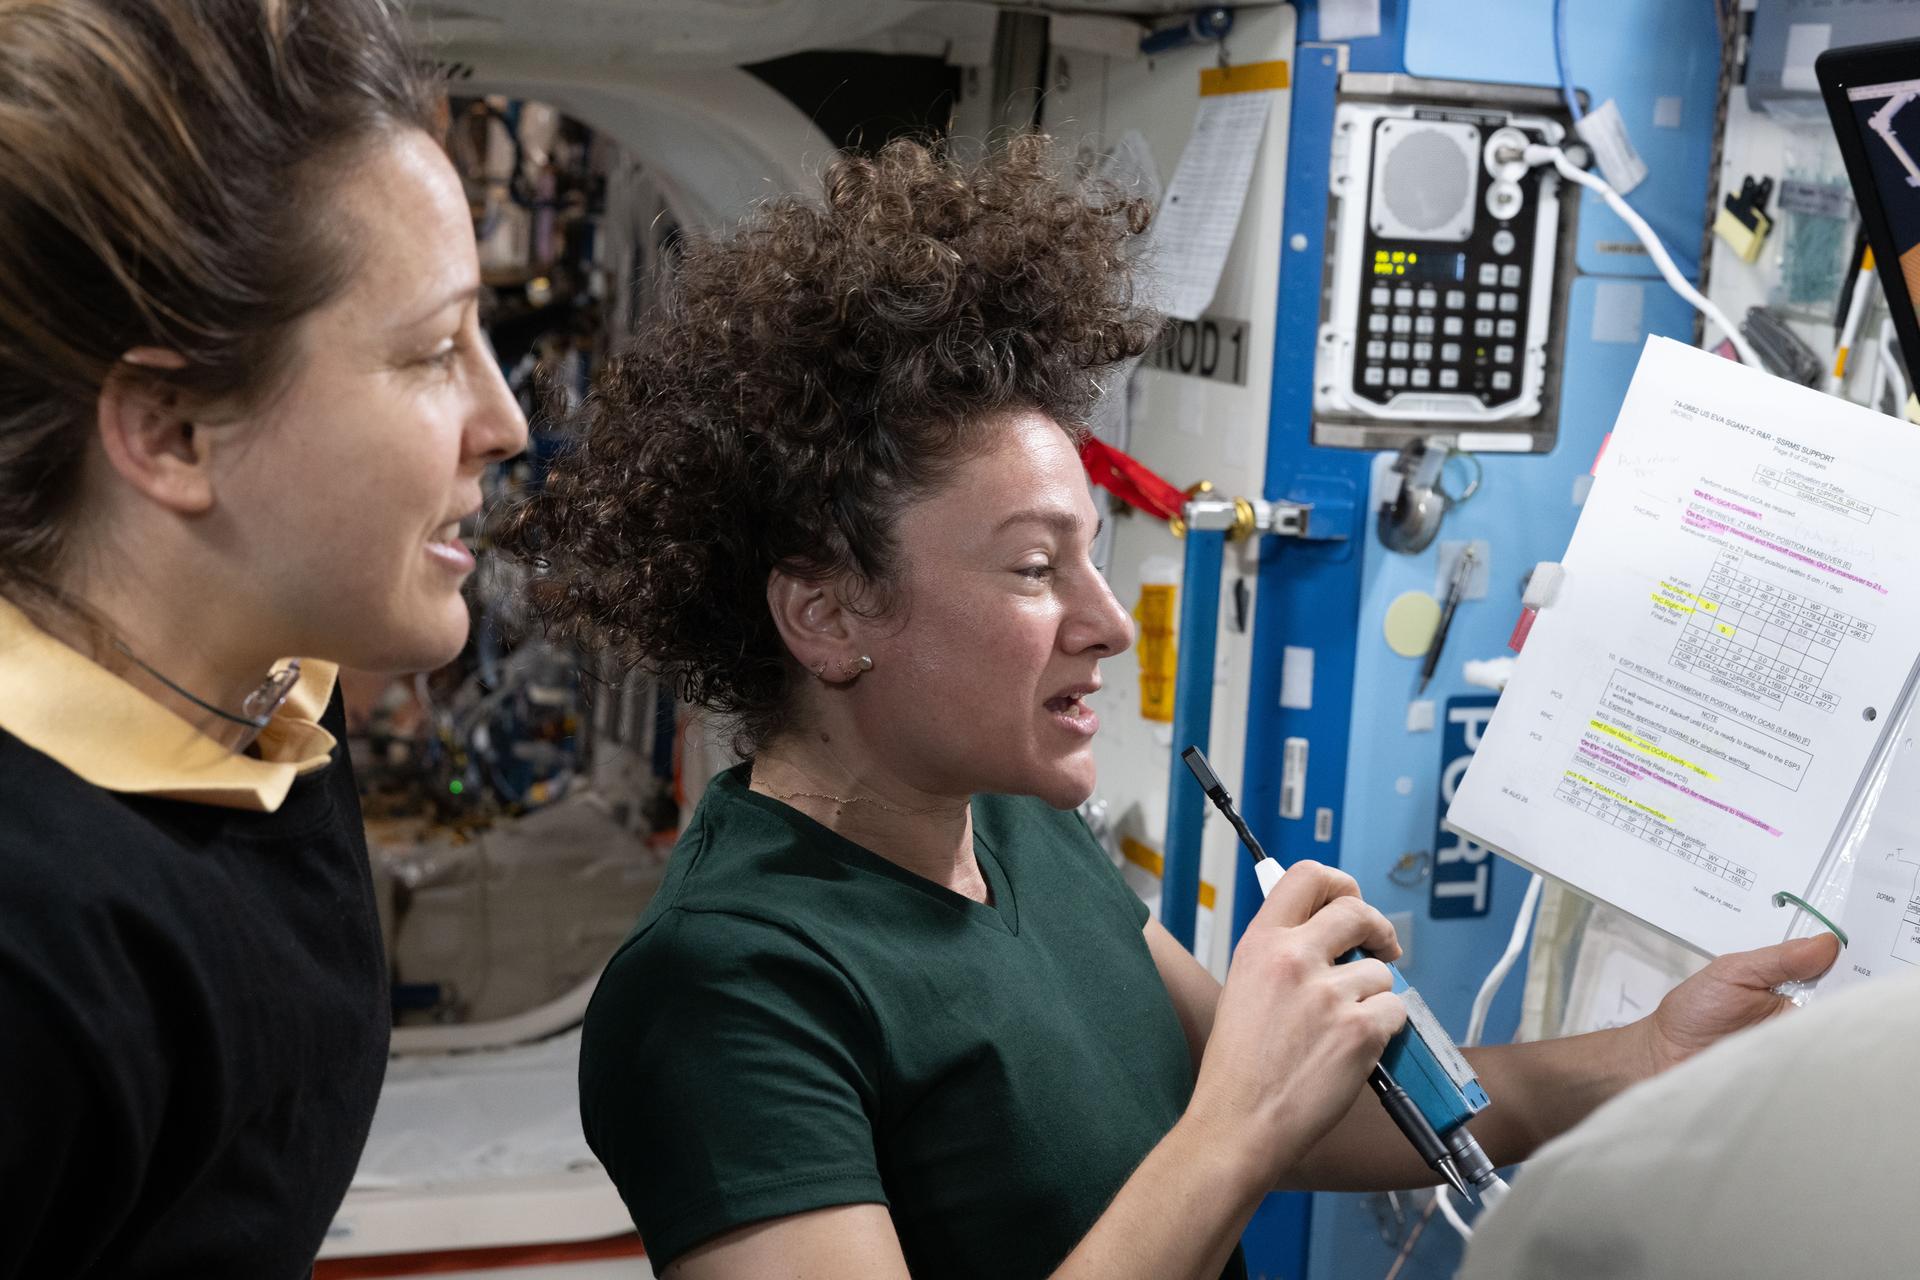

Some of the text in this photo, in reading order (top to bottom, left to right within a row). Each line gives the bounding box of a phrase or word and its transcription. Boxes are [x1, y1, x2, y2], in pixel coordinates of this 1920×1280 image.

[1231, 326, 1243, 383] 1
[1710, 412, 1726, 423] EVA
[1725, 418, 1756, 434] SGANT-2
[1775, 436, 1801, 451] SSRMS
[1800, 445, 1835, 463] SUPPORT
[1772, 445, 1788, 456] Page
[1807, 458, 1827, 471] pages
[1783, 476, 1815, 492] EVA-Chest
[1855, 503, 1871, 513] Lock
[1784, 467, 1821, 485] Continuation
[1827, 483, 1845, 494] Table
[1743, 549, 1765, 563] Backoff
[1764, 558, 1787, 571] position
[1754, 536, 1766, 546] and
[1765, 541, 1789, 555] Handoff
[1826, 565, 1837, 573] for
[1835, 568, 1866, 585] maneuver
[1774, 535, 1806, 552] POSITION
[1805, 547, 1842, 566] MANEUVER
[1677, 651, 1691, 661] FOR
[1698, 660, 1727, 676] EVA-Chest
[1767, 689, 1781, 699] Lock
[1665, 678, 1708, 701] INTERMEDIATE
[1708, 696, 1738, 714] POSITION
[1738, 709, 1756, 722] JOINT
[1756, 717, 1775, 730] OCAS
[1701, 711, 1718, 722] NOTE
[1607, 701, 1626, 714] Expect
[1625, 709, 1635, 718] the
[1635, 713, 1667, 733] approaching
[1667, 728, 1689, 742] SSRMS
[1699, 742, 1728, 760] singularity
[1617, 731, 1633, 742] Mode
[1637, 740, 1651, 750] Joint
[1650, 746, 1668, 758] OCAS
[1626, 690, 1636, 698] will
[1635, 693, 1654, 706] remain
[1668, 708, 1689, 722] Backoff
[1689, 717, 1702, 727] until
[1701, 722, 1714, 733] EV2
[1719, 730, 1736, 742] ready
[1742, 740, 1768, 756] translate
[1773, 754, 1784, 763] the
[1783, 758, 1800, 771] ESP3
[1636, 728, 1658, 742] SSRMS
[1574, 755, 1627, 783] SSRMS Joint OCAS
[1614, 745, 1635, 759] Desired
[1634, 754, 1652, 767] (Verify
[1652, 762, 1666, 773] Rate
[1673, 772, 1688, 784] PCS)
[1644, 814, 1652, 822] for
[1652, 818, 1685, 838] Intermediate
[1689, 789, 1698, 797] for
[1735, 810, 1770, 830] Intermediate
